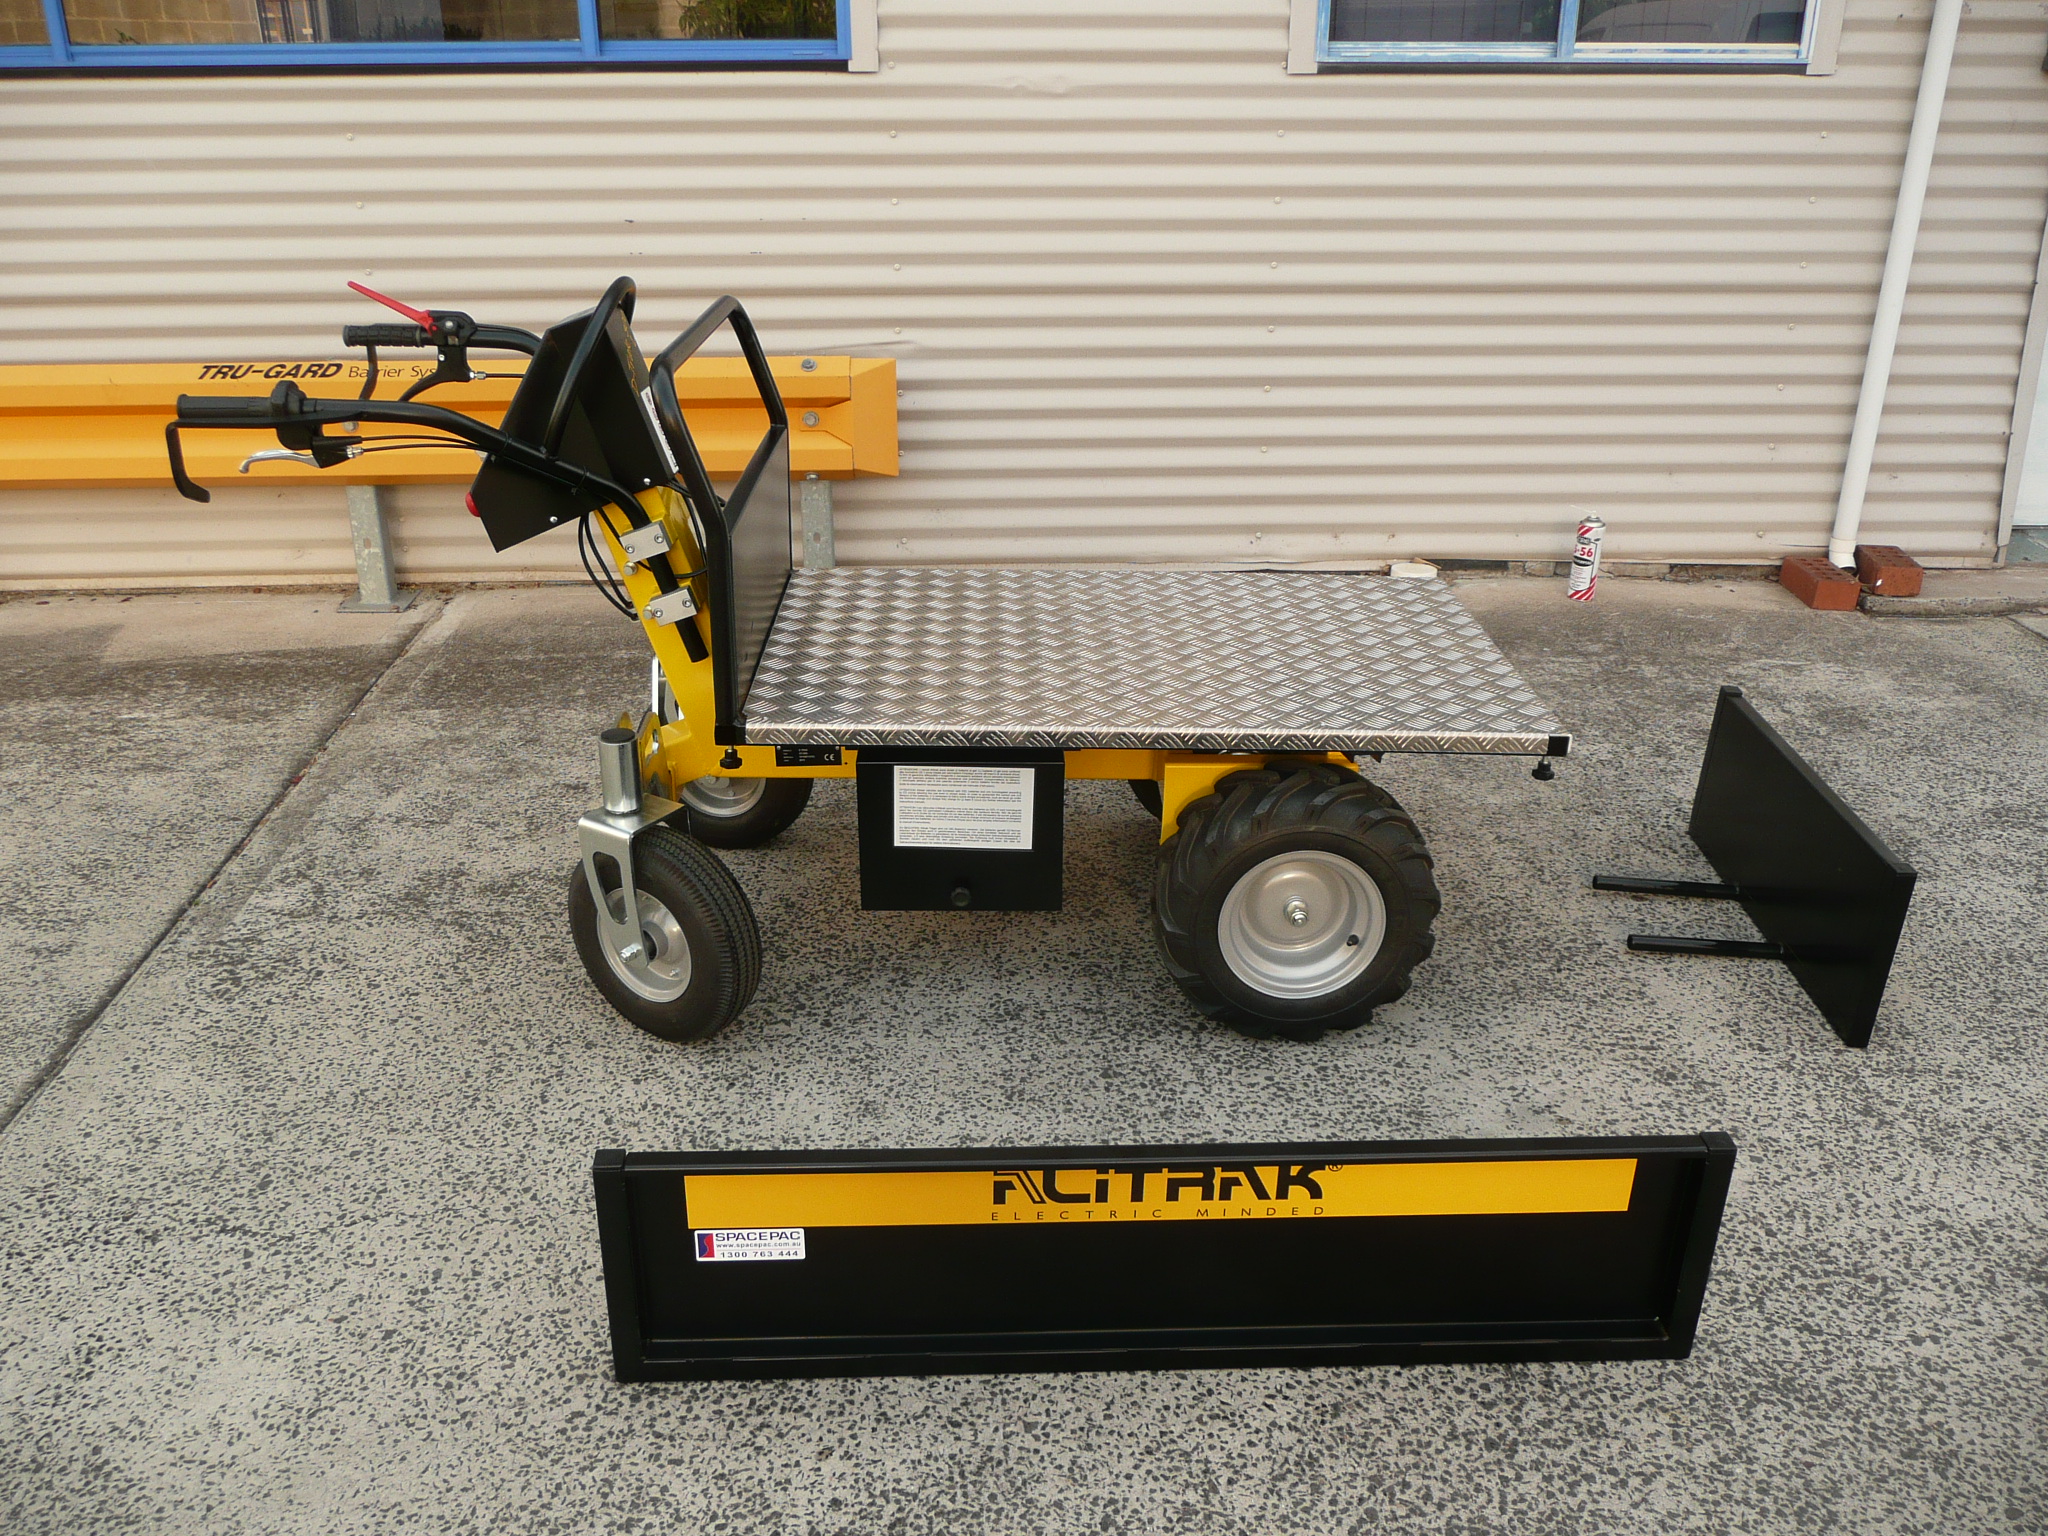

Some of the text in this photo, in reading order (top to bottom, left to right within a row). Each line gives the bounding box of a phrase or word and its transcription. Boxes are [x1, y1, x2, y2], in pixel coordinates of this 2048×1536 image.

[198, 362, 343, 379] TRU-GARD
[348, 365, 405, 378] Barier
[991, 1206, 1324, 1221] ELECTRIC MINDED
[715, 1231, 801, 1241] SPACEPAC
[716, 1241, 801, 1249] www.spacepac.com.au
